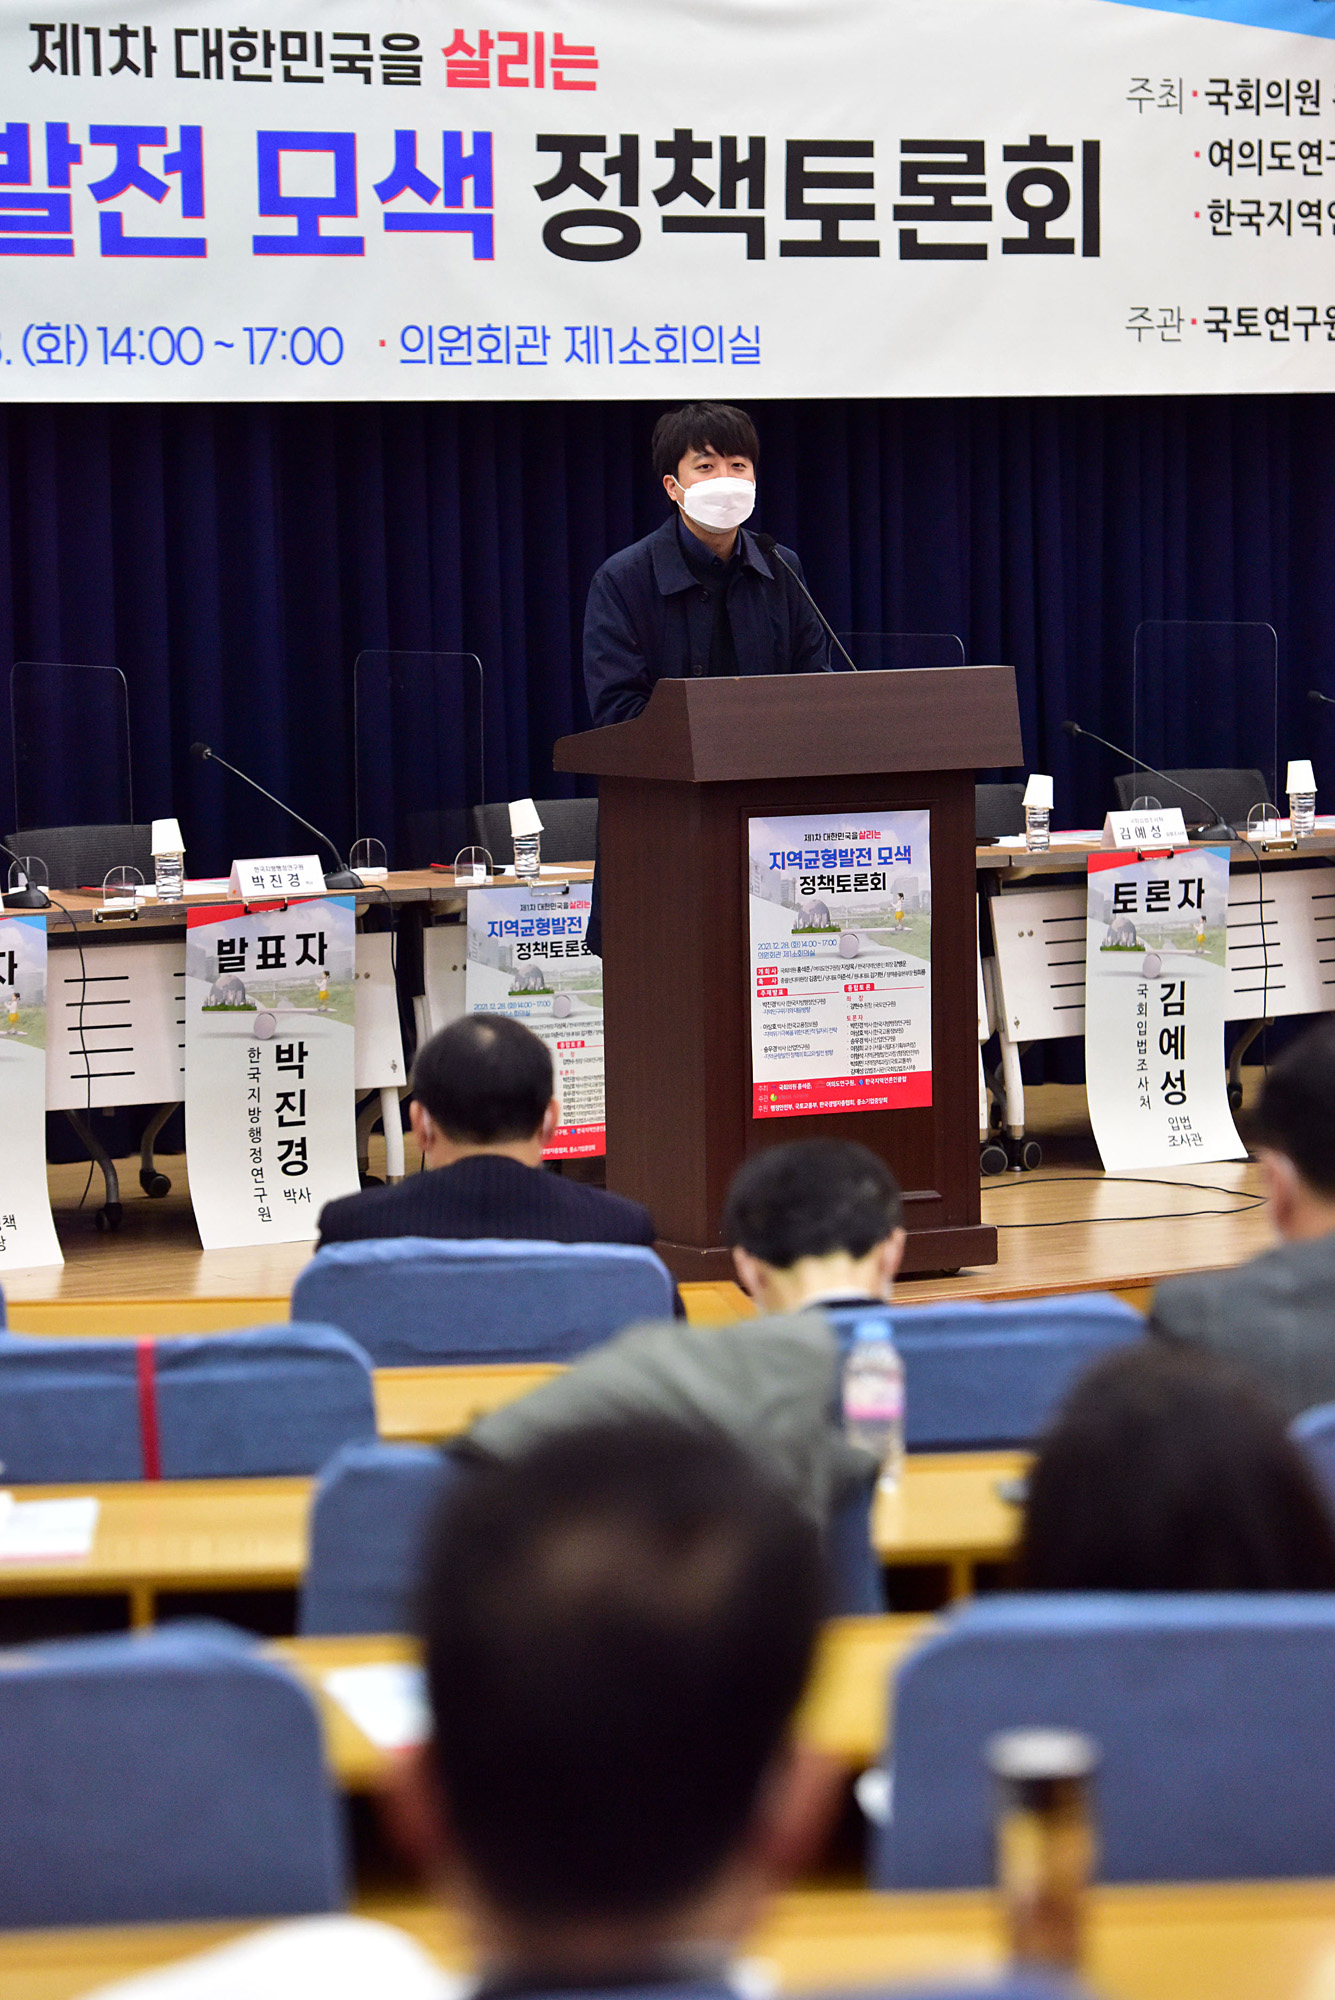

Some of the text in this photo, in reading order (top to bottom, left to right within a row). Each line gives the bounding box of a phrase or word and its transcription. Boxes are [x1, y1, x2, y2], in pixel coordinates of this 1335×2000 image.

[28, 23, 600, 92] 제1차 대한민국을 살리는
[1125, 76, 1184, 116] 주최
[1204, 78, 1322, 117] 국회의원
[0, 121, 1101, 262] 발전 모색 정책토론회
[1125, 306, 1184, 344] 주관
[400, 322, 550, 367] 의원회관
[564, 322, 762, 367] 제1소회의실
[804, 830, 882, 842] 제1차 대한민국을 살리는
[1119, 826, 1162, 841] 김예성
[769, 845, 912, 872] 지역균형발전 모색
[251, 873, 301, 889] 박진경
[800, 871, 887, 896] 정책토론회
[1112, 877, 1206, 914] 토론자
[537, 902, 569, 911] 대한민국을
[569, 899, 591, 910] 살리는
[487, 917, 583, 938] 지역균형발전
[216, 931, 329, 973] 발표자
[1136, 983, 1152, 1110] 국회입법조사처
[1158, 980, 1188, 1107] 김예성
[275, 1041, 309, 1177] 박진경
[1167, 1115, 1193, 1131] 입법
[246, 1046, 273, 1223] 한국지방행정연구원
[1167, 1132, 1204, 1149] 조사관
[282, 1187, 312, 1205] 박사
